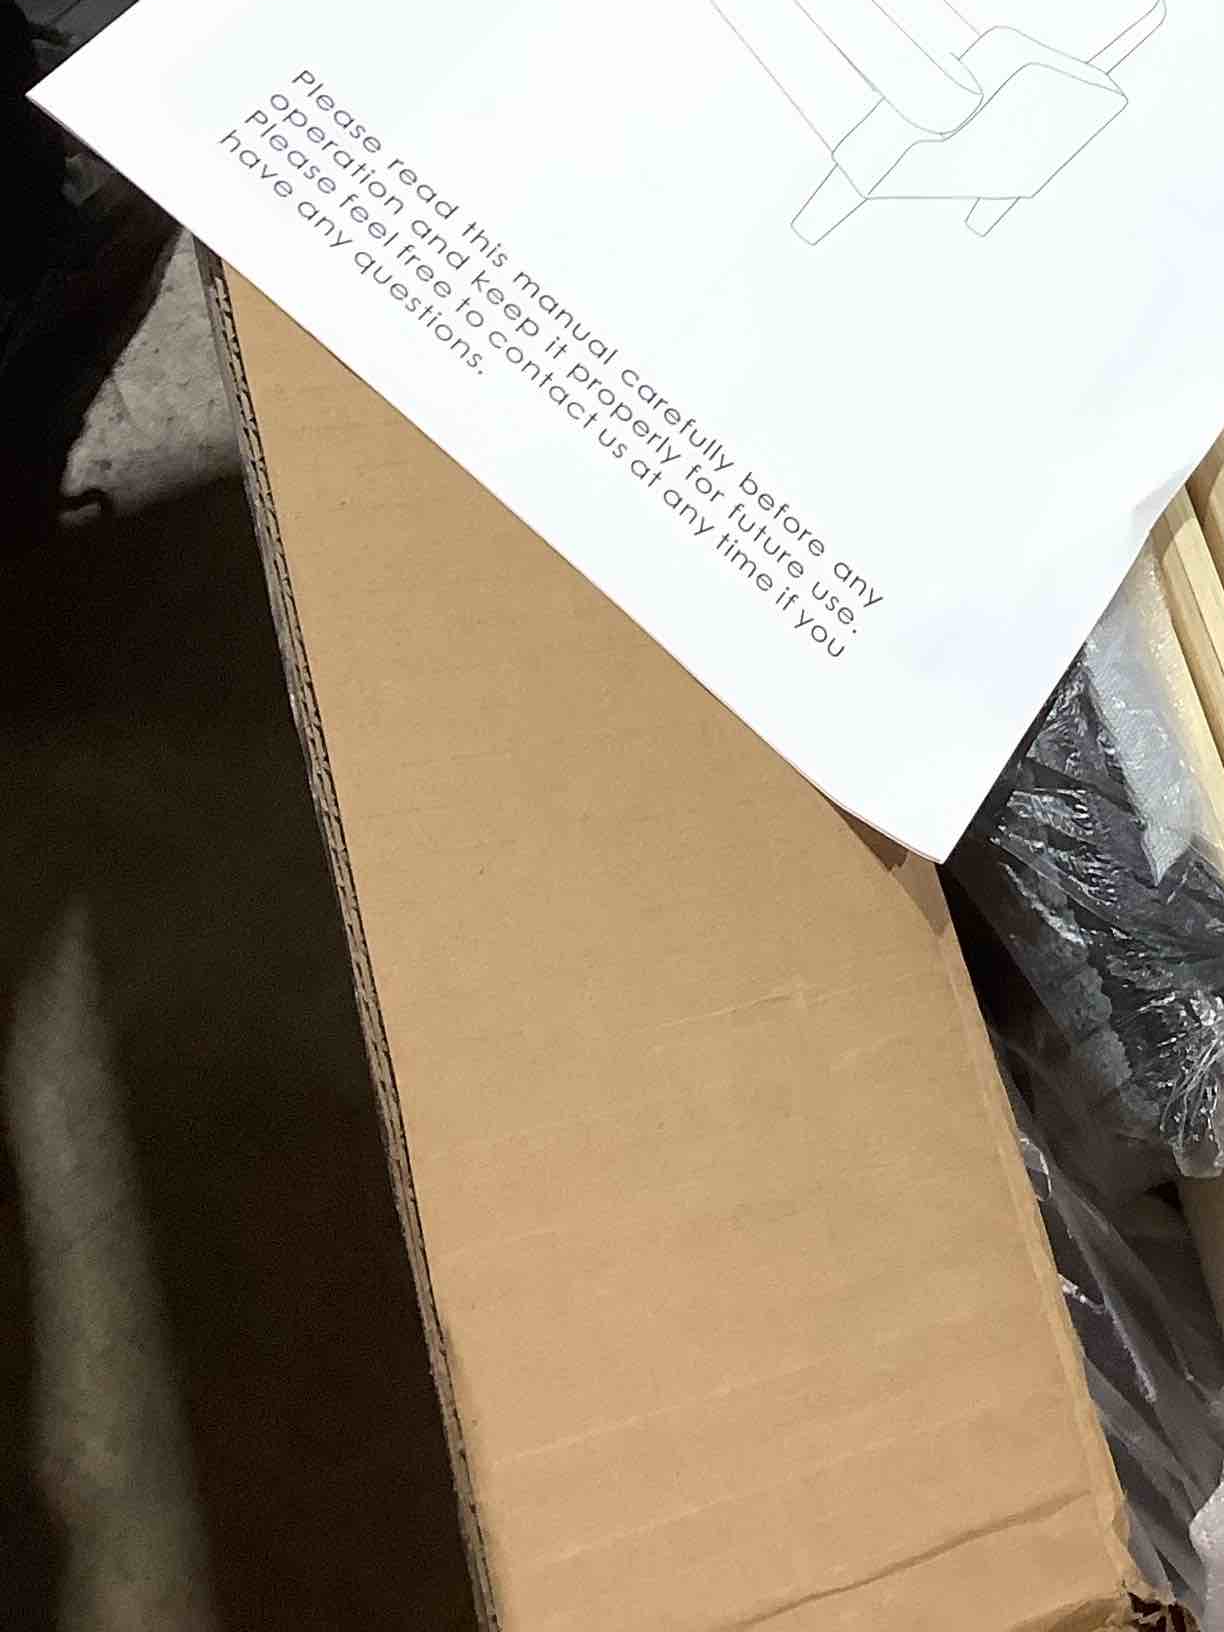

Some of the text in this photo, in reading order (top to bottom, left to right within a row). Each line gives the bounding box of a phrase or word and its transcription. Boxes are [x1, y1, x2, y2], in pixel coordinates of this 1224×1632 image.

[217, 128, 484, 376] have any questions.
[243, 109, 846, 658] Please feel free to contact us at any time if you
[269, 93, 857, 635] operation and keep it properly for future use.
[290, 69, 884, 609] Please read this manual carefully before any
